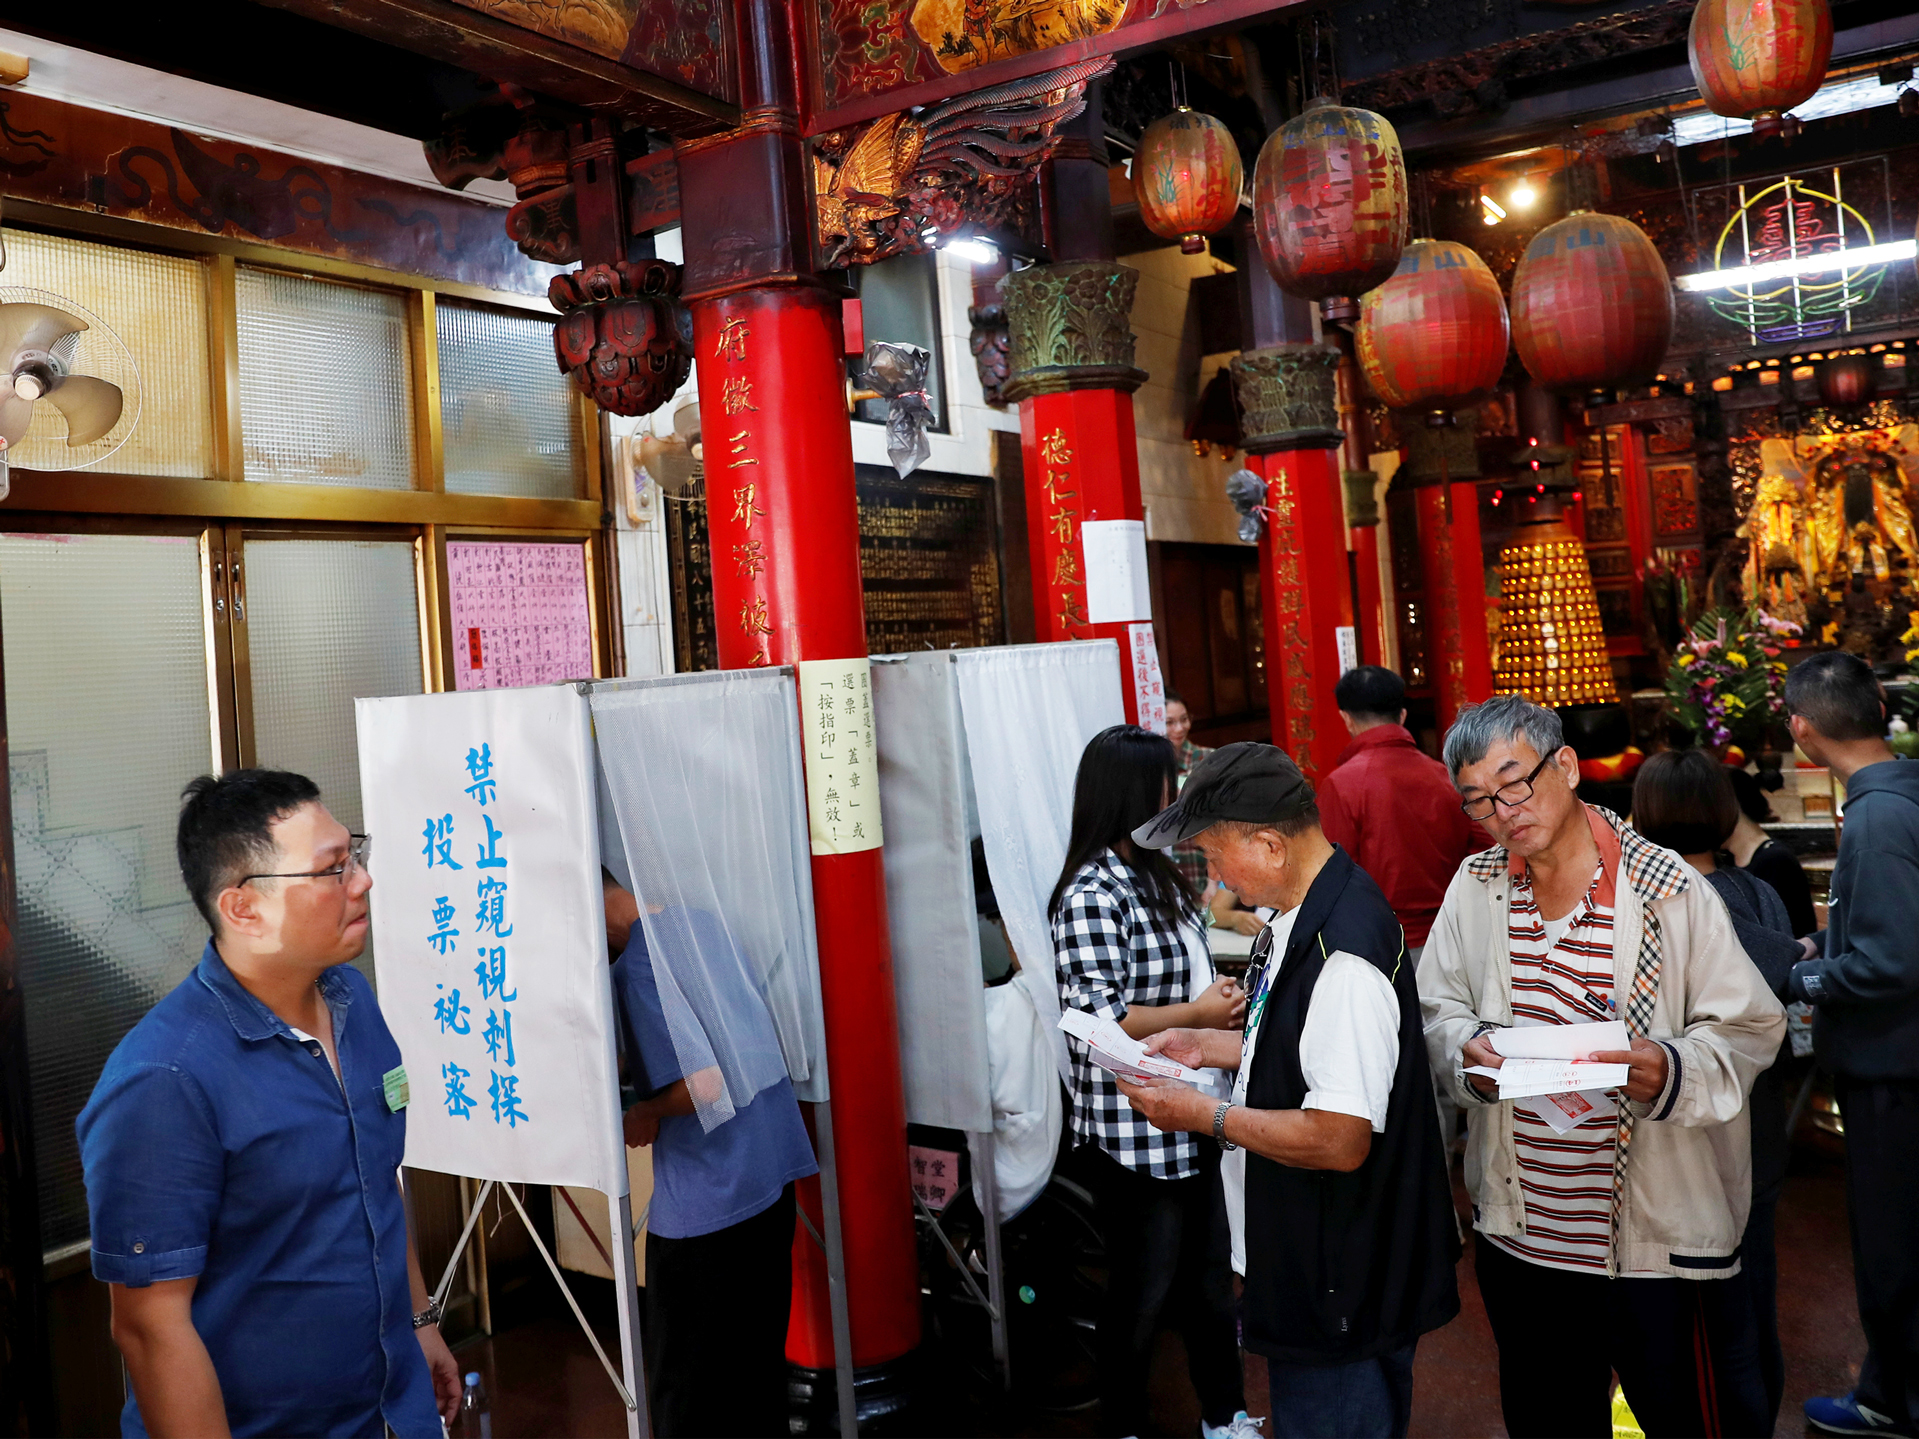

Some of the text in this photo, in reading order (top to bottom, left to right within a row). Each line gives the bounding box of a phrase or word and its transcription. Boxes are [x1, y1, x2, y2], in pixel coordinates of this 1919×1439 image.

[1041, 427, 1090, 641] 德仁有慶長
[841, 672, 866, 840] 選票「蓋章」或
[421, 812, 479, 1122] 投票祕密
[463, 741, 530, 1130] 禁止窺視刺探
